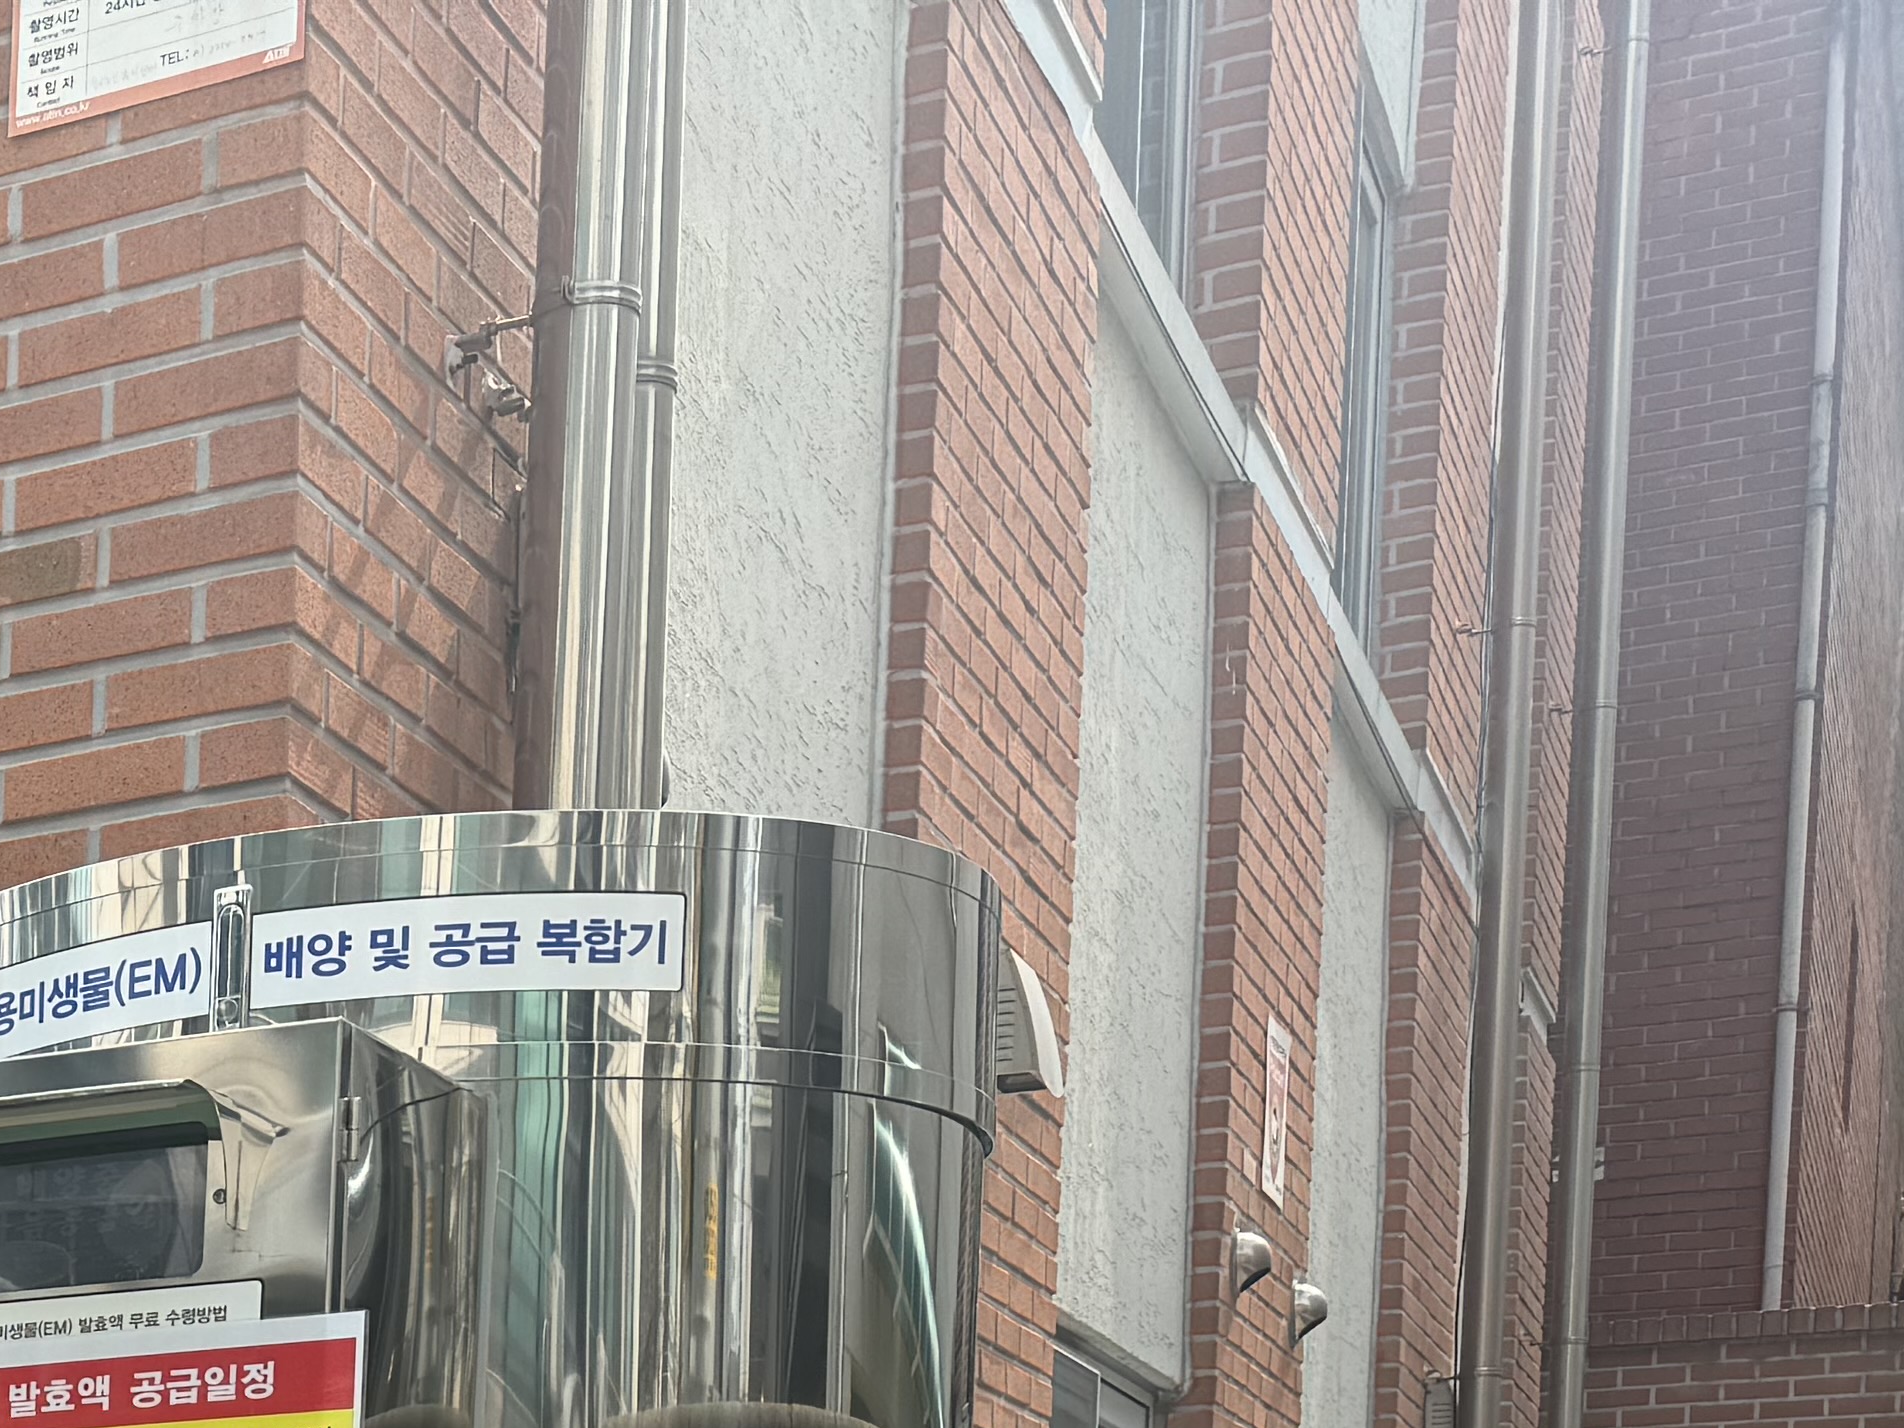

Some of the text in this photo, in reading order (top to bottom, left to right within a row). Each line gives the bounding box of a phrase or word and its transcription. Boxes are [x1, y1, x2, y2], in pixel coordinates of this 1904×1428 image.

[160, 49, 190, 67] TEL:
[263, 915, 669, 979] 배양 및 공급 복합기
[78, 1313, 124, 1333] 발효액
[128, 1309, 161, 1328] 무료
[165, 1304, 228, 1326] 수령방법
[8, 1360, 276, 1418] 발효액 공급일정
